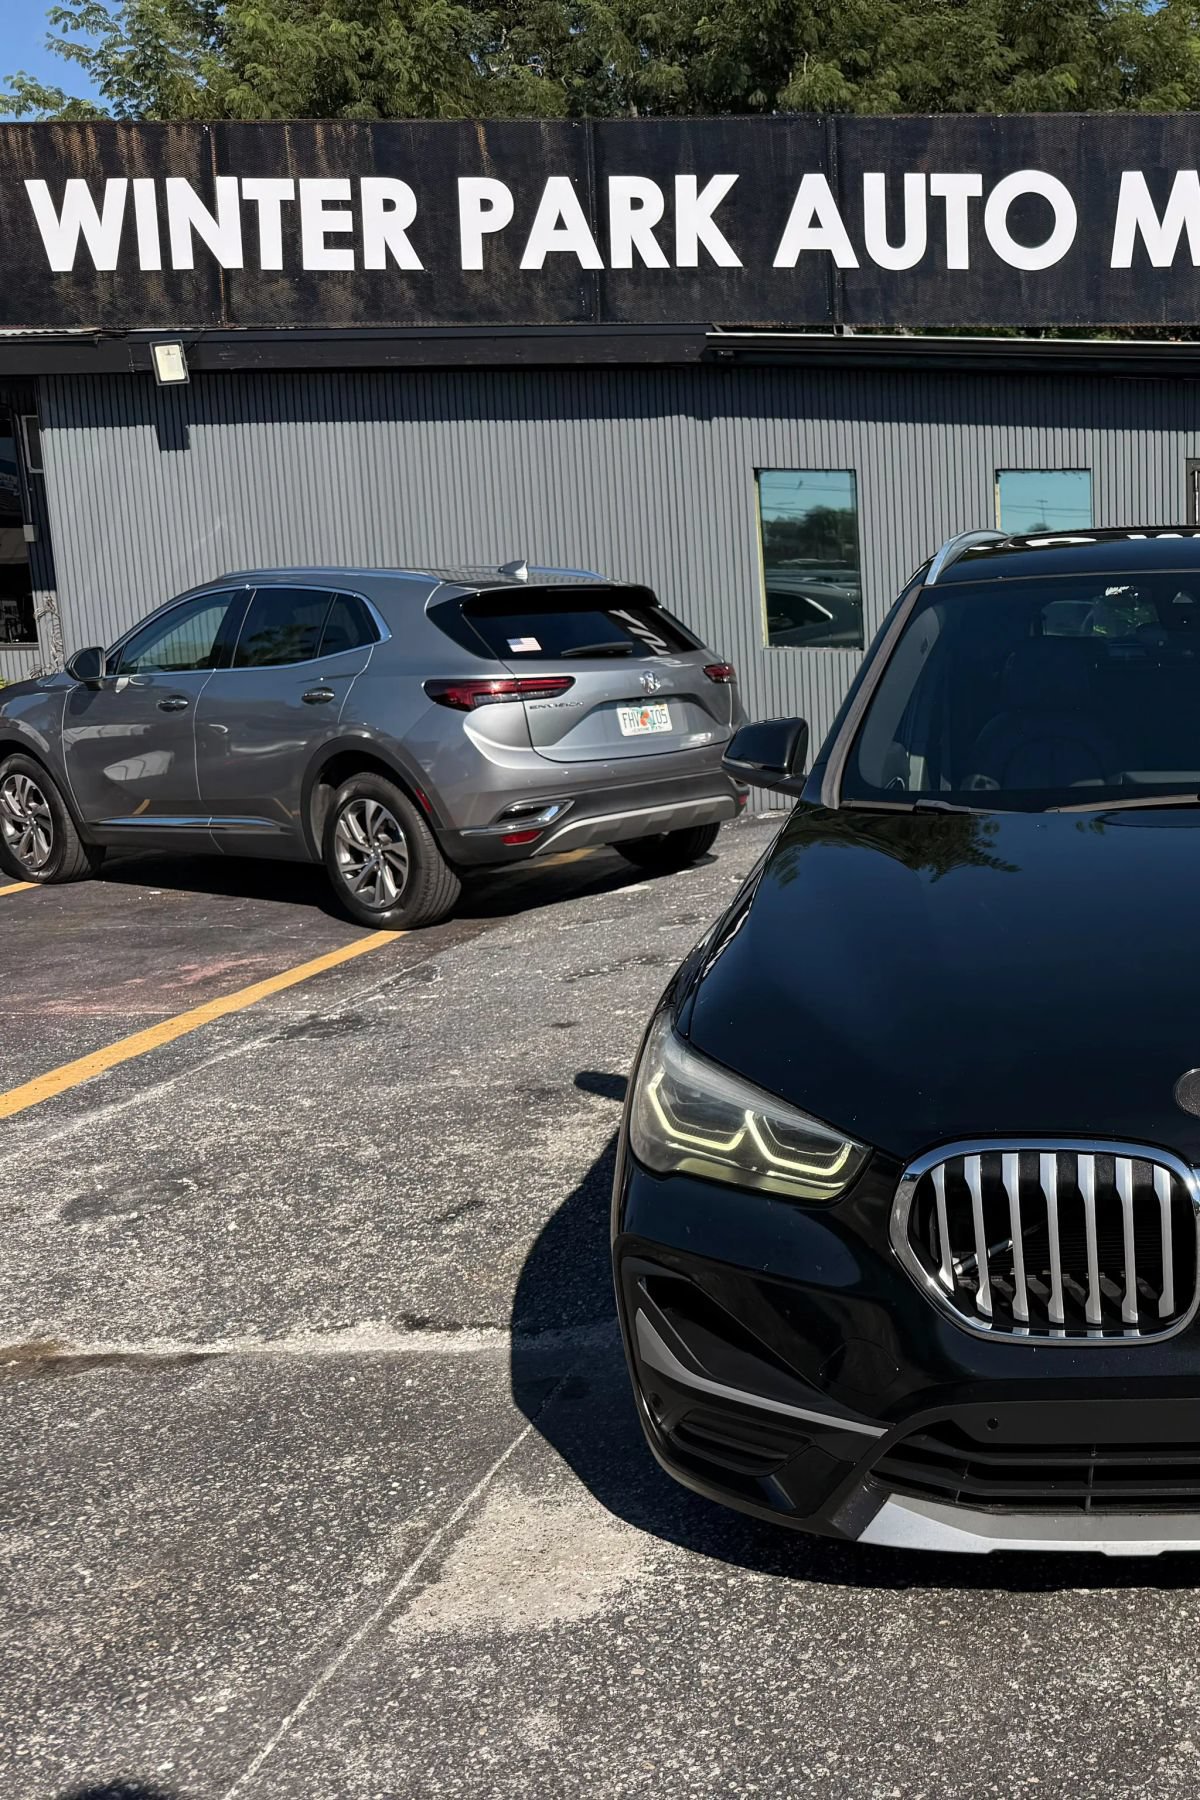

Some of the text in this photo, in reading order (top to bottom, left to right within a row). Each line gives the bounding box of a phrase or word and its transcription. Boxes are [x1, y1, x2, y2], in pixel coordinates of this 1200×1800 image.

[24, 175, 425, 273] WINTER
[456, 174, 743, 271] PARK
[772, 169, 1078, 271] AUTO
